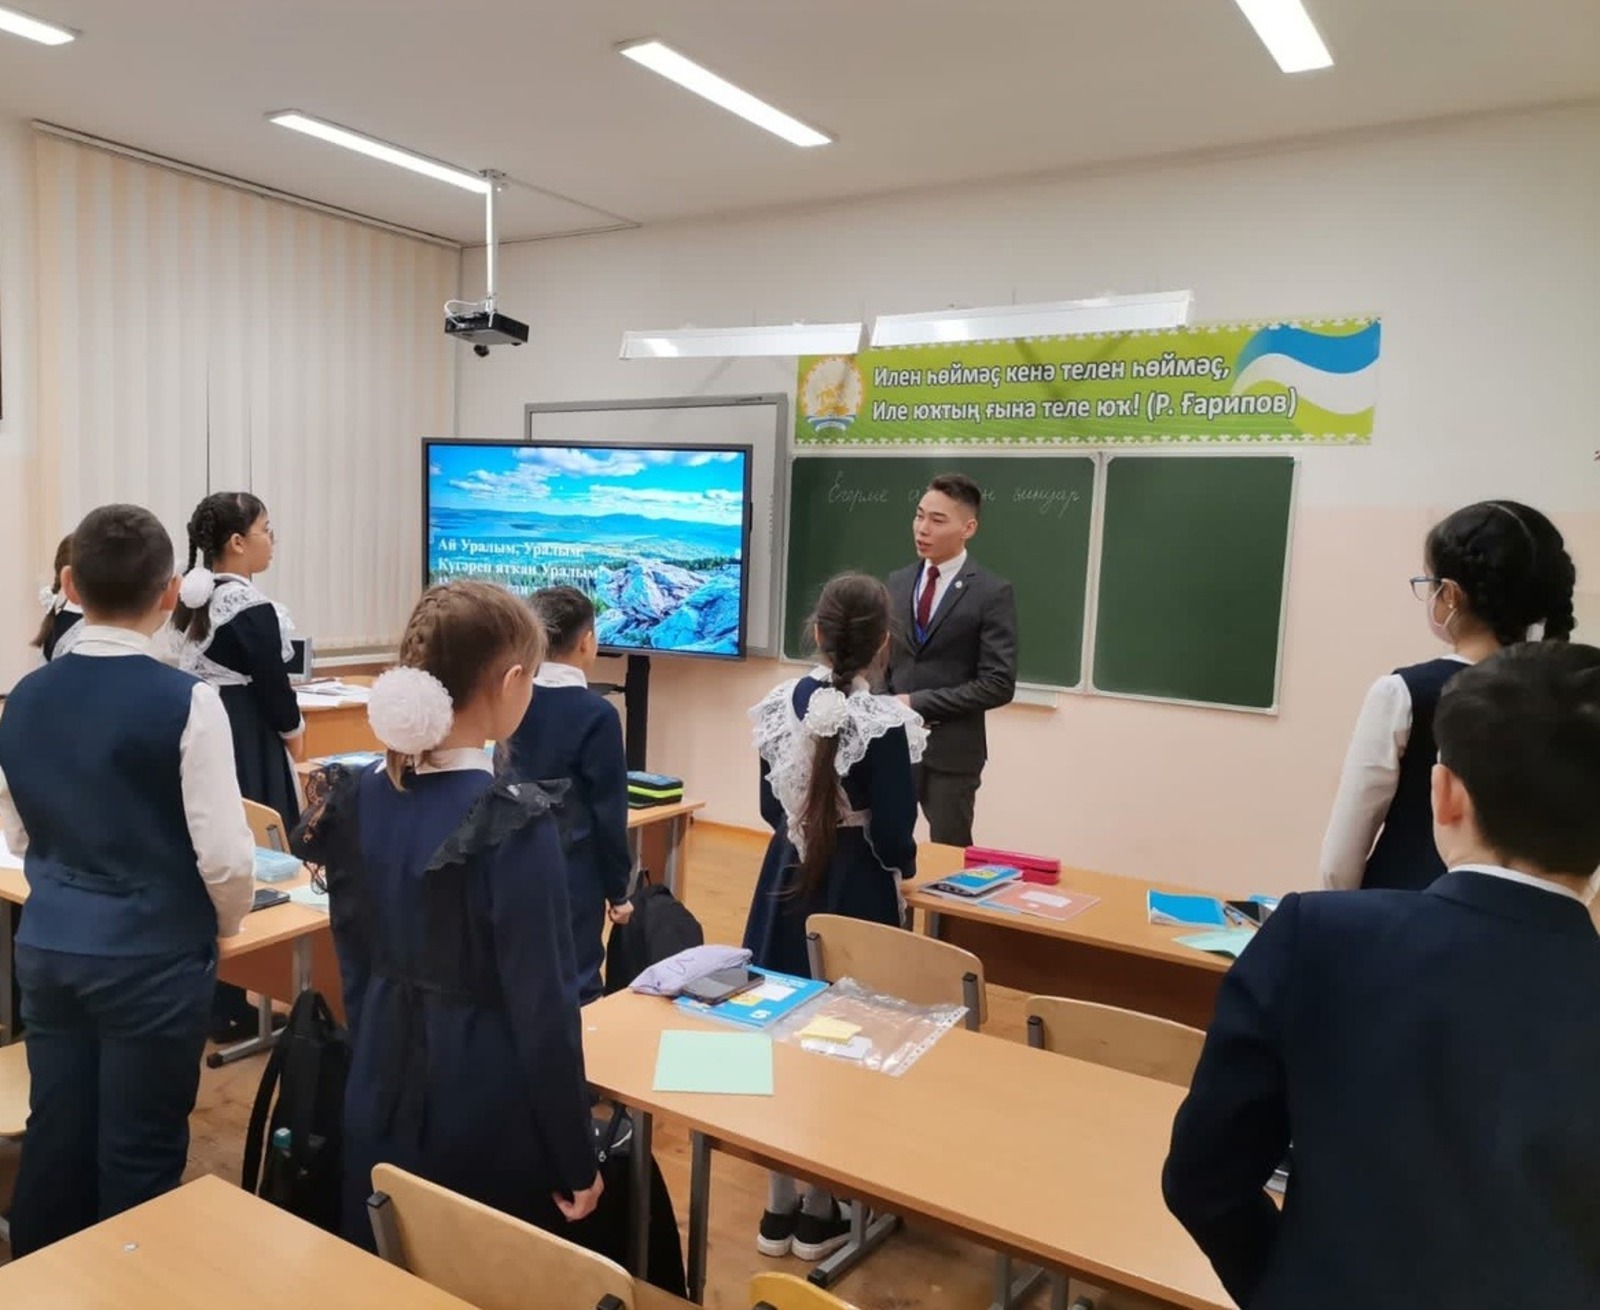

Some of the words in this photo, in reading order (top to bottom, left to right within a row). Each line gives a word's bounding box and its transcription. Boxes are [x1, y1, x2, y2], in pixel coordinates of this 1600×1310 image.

[874, 366, 921, 387] Илен
[927, 362, 1001, 388] һөймәҫ
[1006, 364, 1055, 383] кенә
[1060, 359, 1125, 380] телен
[872, 400, 908, 421] Иле
[985, 401, 1036, 419] ғына
[1042, 397, 1090, 418] теле
[1147, 391, 1174, 421] (Р.
[1181, 387, 1297, 421] Ғарипов)
[438, 538, 457, 551] Ай
[460, 538, 520, 556] Уралым,
